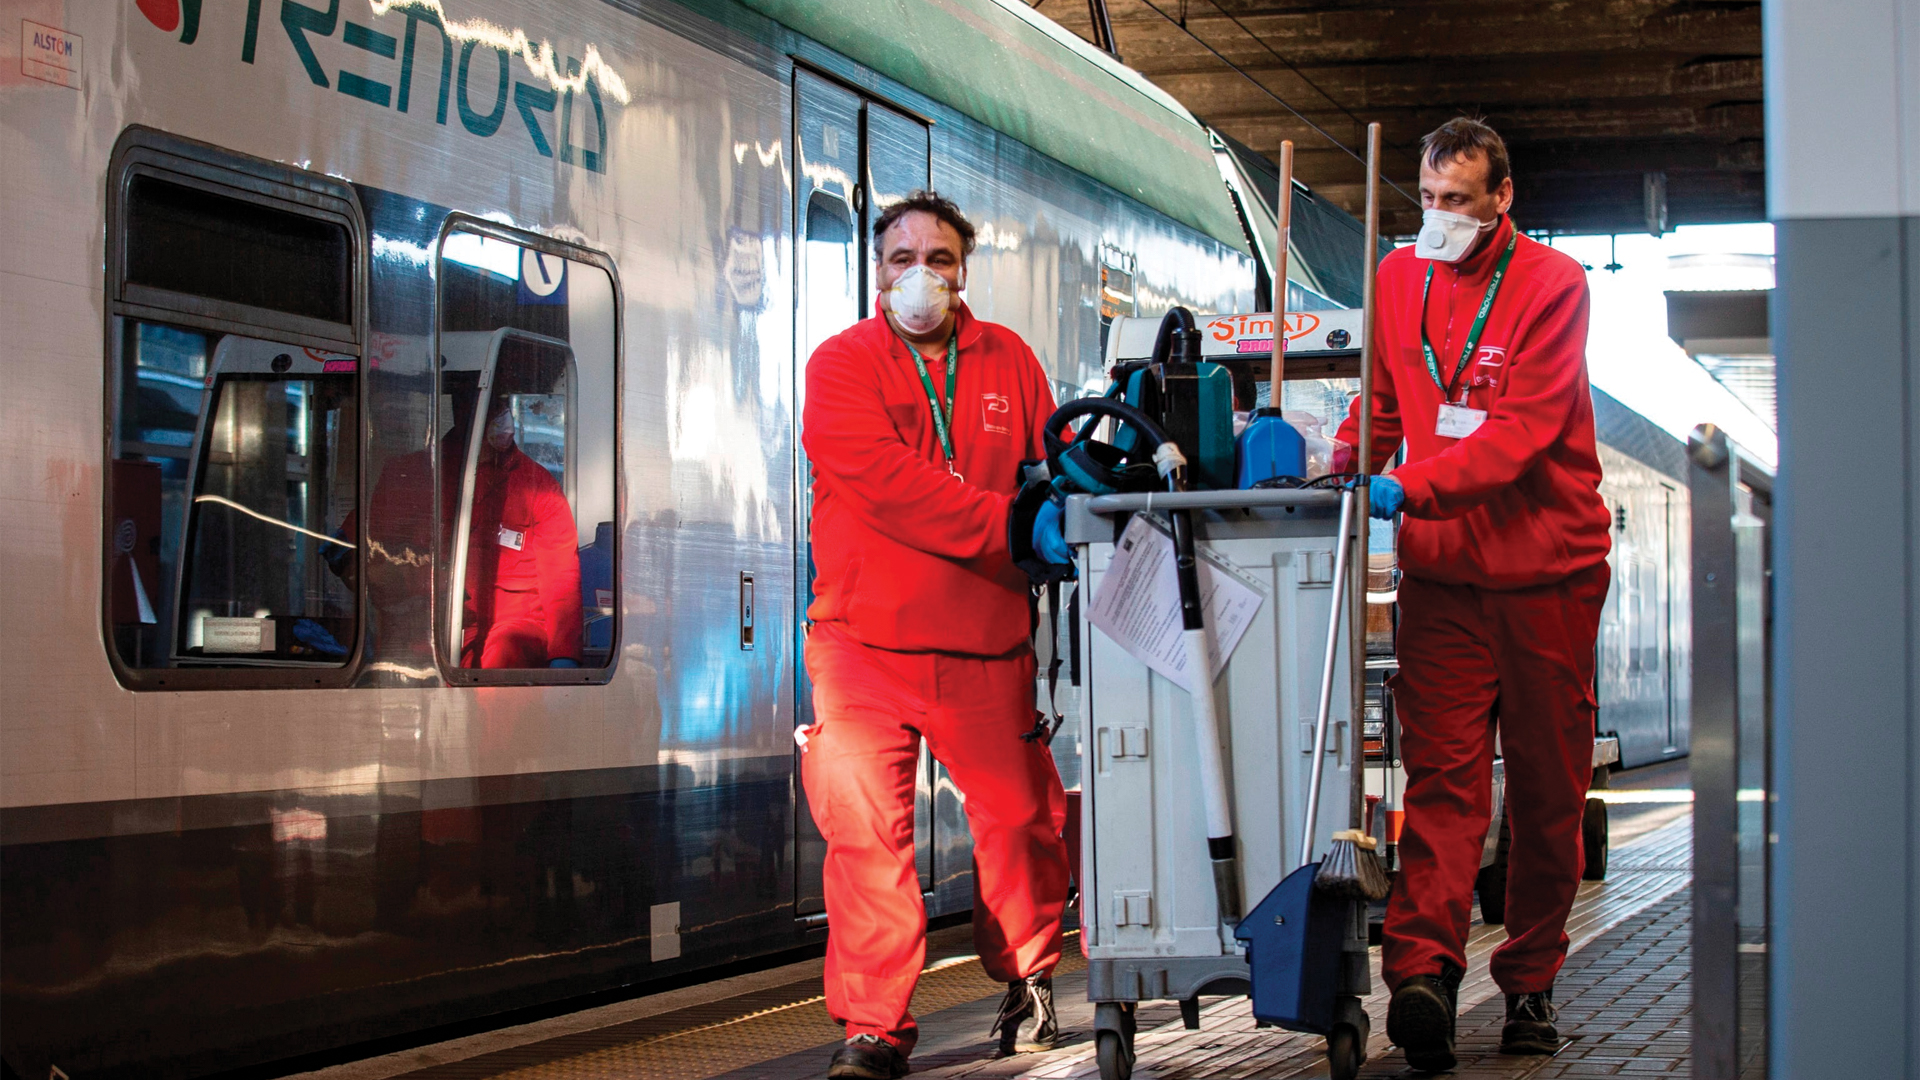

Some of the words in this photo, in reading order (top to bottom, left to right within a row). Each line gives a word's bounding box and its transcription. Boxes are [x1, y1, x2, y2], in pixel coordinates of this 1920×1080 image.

[33, 32, 73, 57] ALSTOM
[1478, 276, 1502, 319] TRENORD
[932, 406, 947, 446] TRENORD
